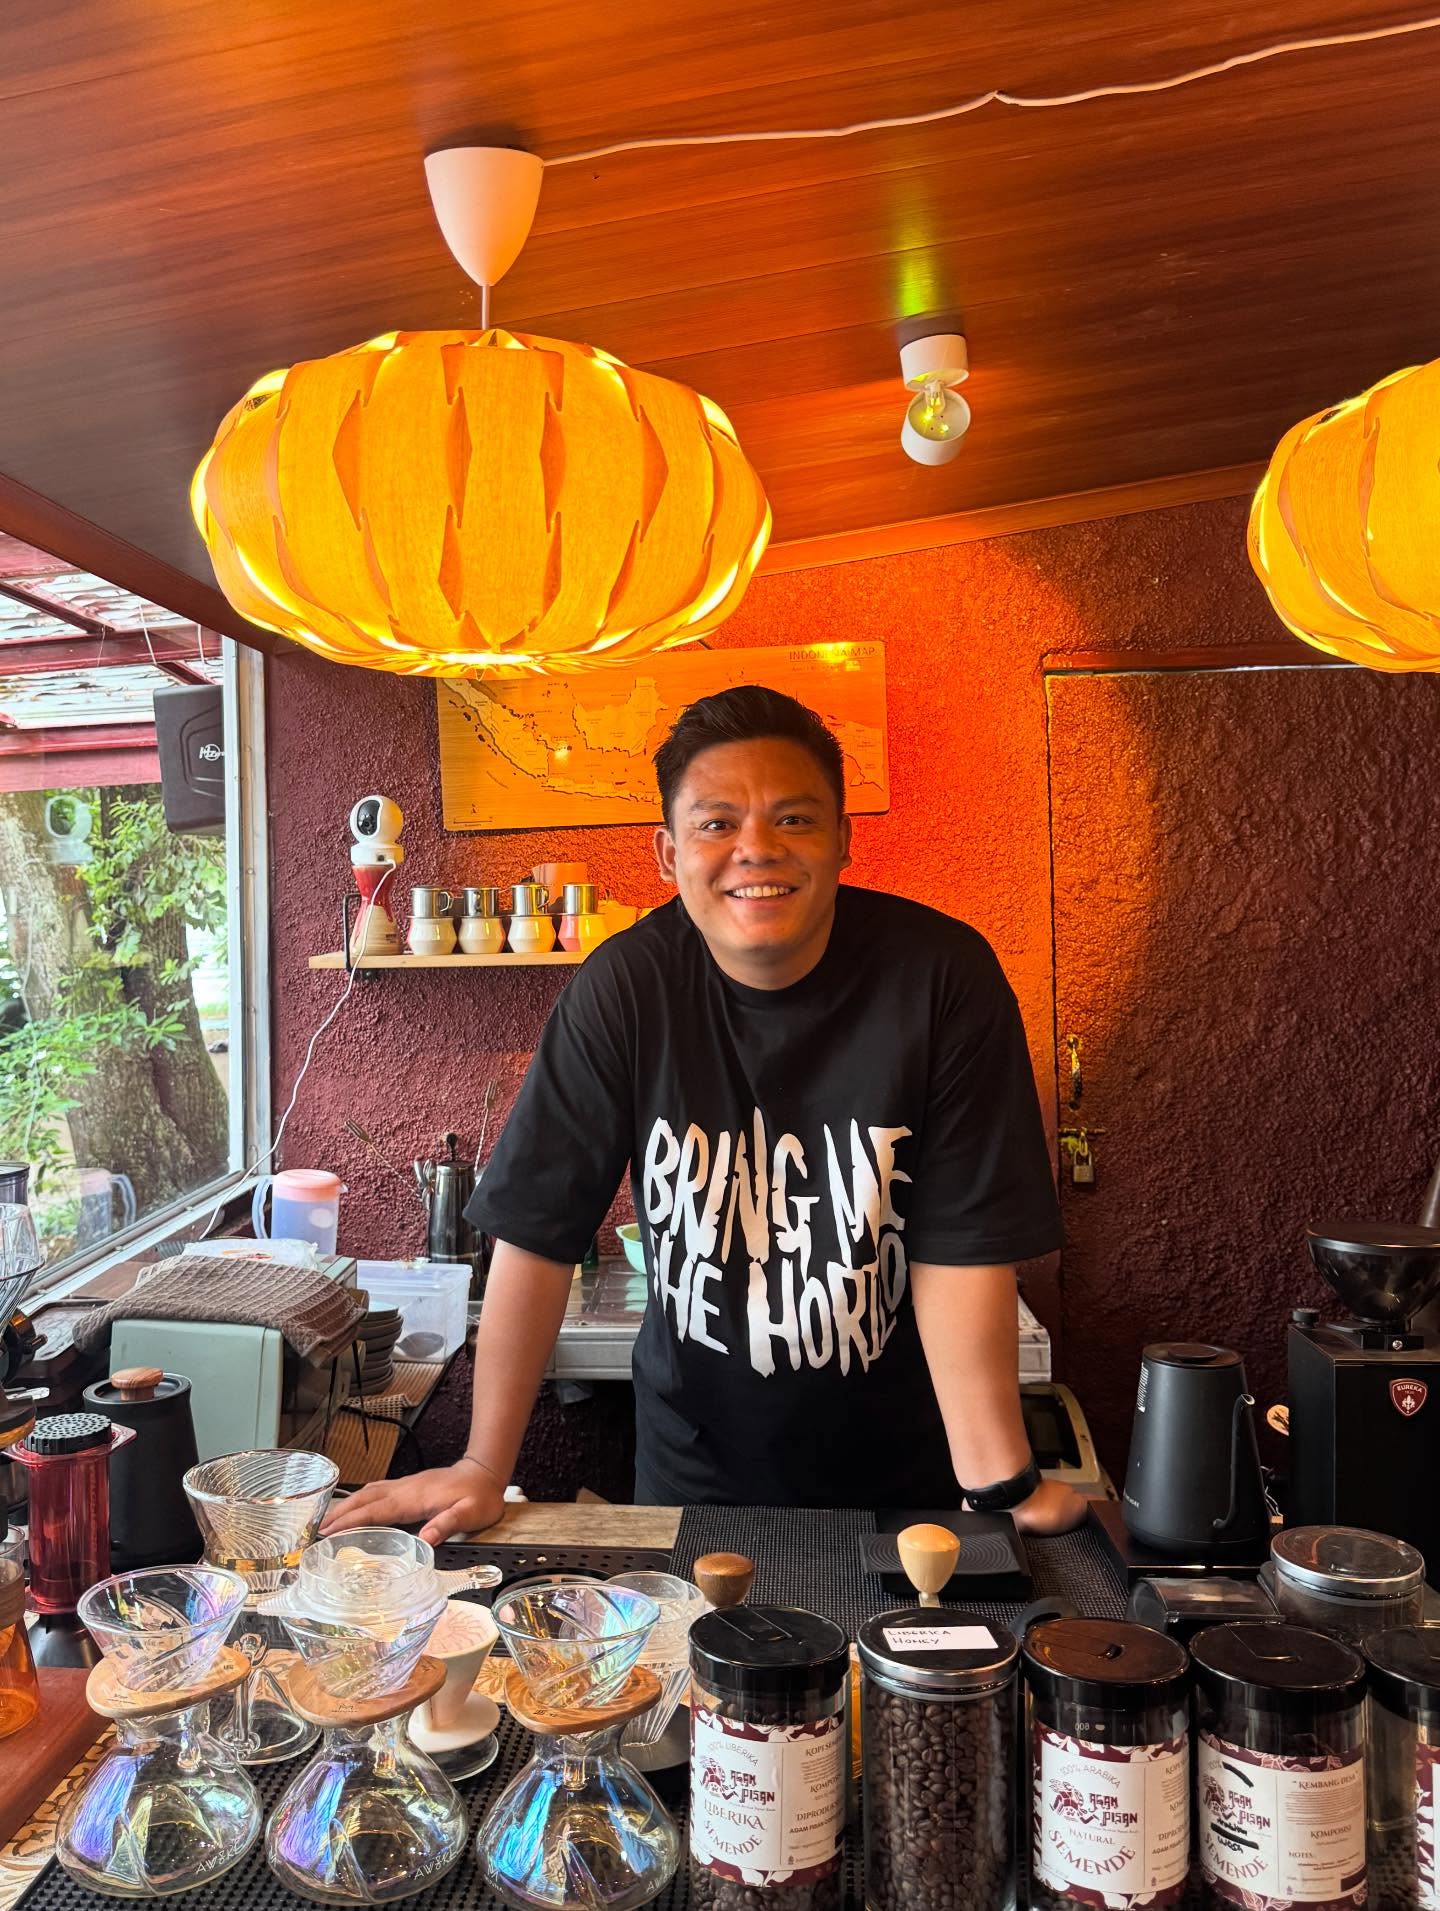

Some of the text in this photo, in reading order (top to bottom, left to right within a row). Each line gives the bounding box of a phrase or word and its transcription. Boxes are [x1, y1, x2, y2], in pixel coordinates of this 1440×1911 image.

[789, 646, 876, 660] INDONIA MAP
[643, 1106, 913, 1270] BRING ME
[747, 1232, 907, 1378] HORIO
[1396, 1384, 1423, 1393] EUREKA
[725, 1741, 759, 1767] LIBERIKA
[1083, 1764, 1121, 1791] ARABIKA
[704, 1799, 767, 1831] LIBERIKA
[1100, 1810, 1138, 1828] PISAN
[703, 1820, 762, 1856] SEMENDE
[1069, 1827, 1116, 1845] NATURAL
[1048, 1829, 1137, 1876] SEMENDE
[1205, 1832, 1269, 1879] SEMENDE
